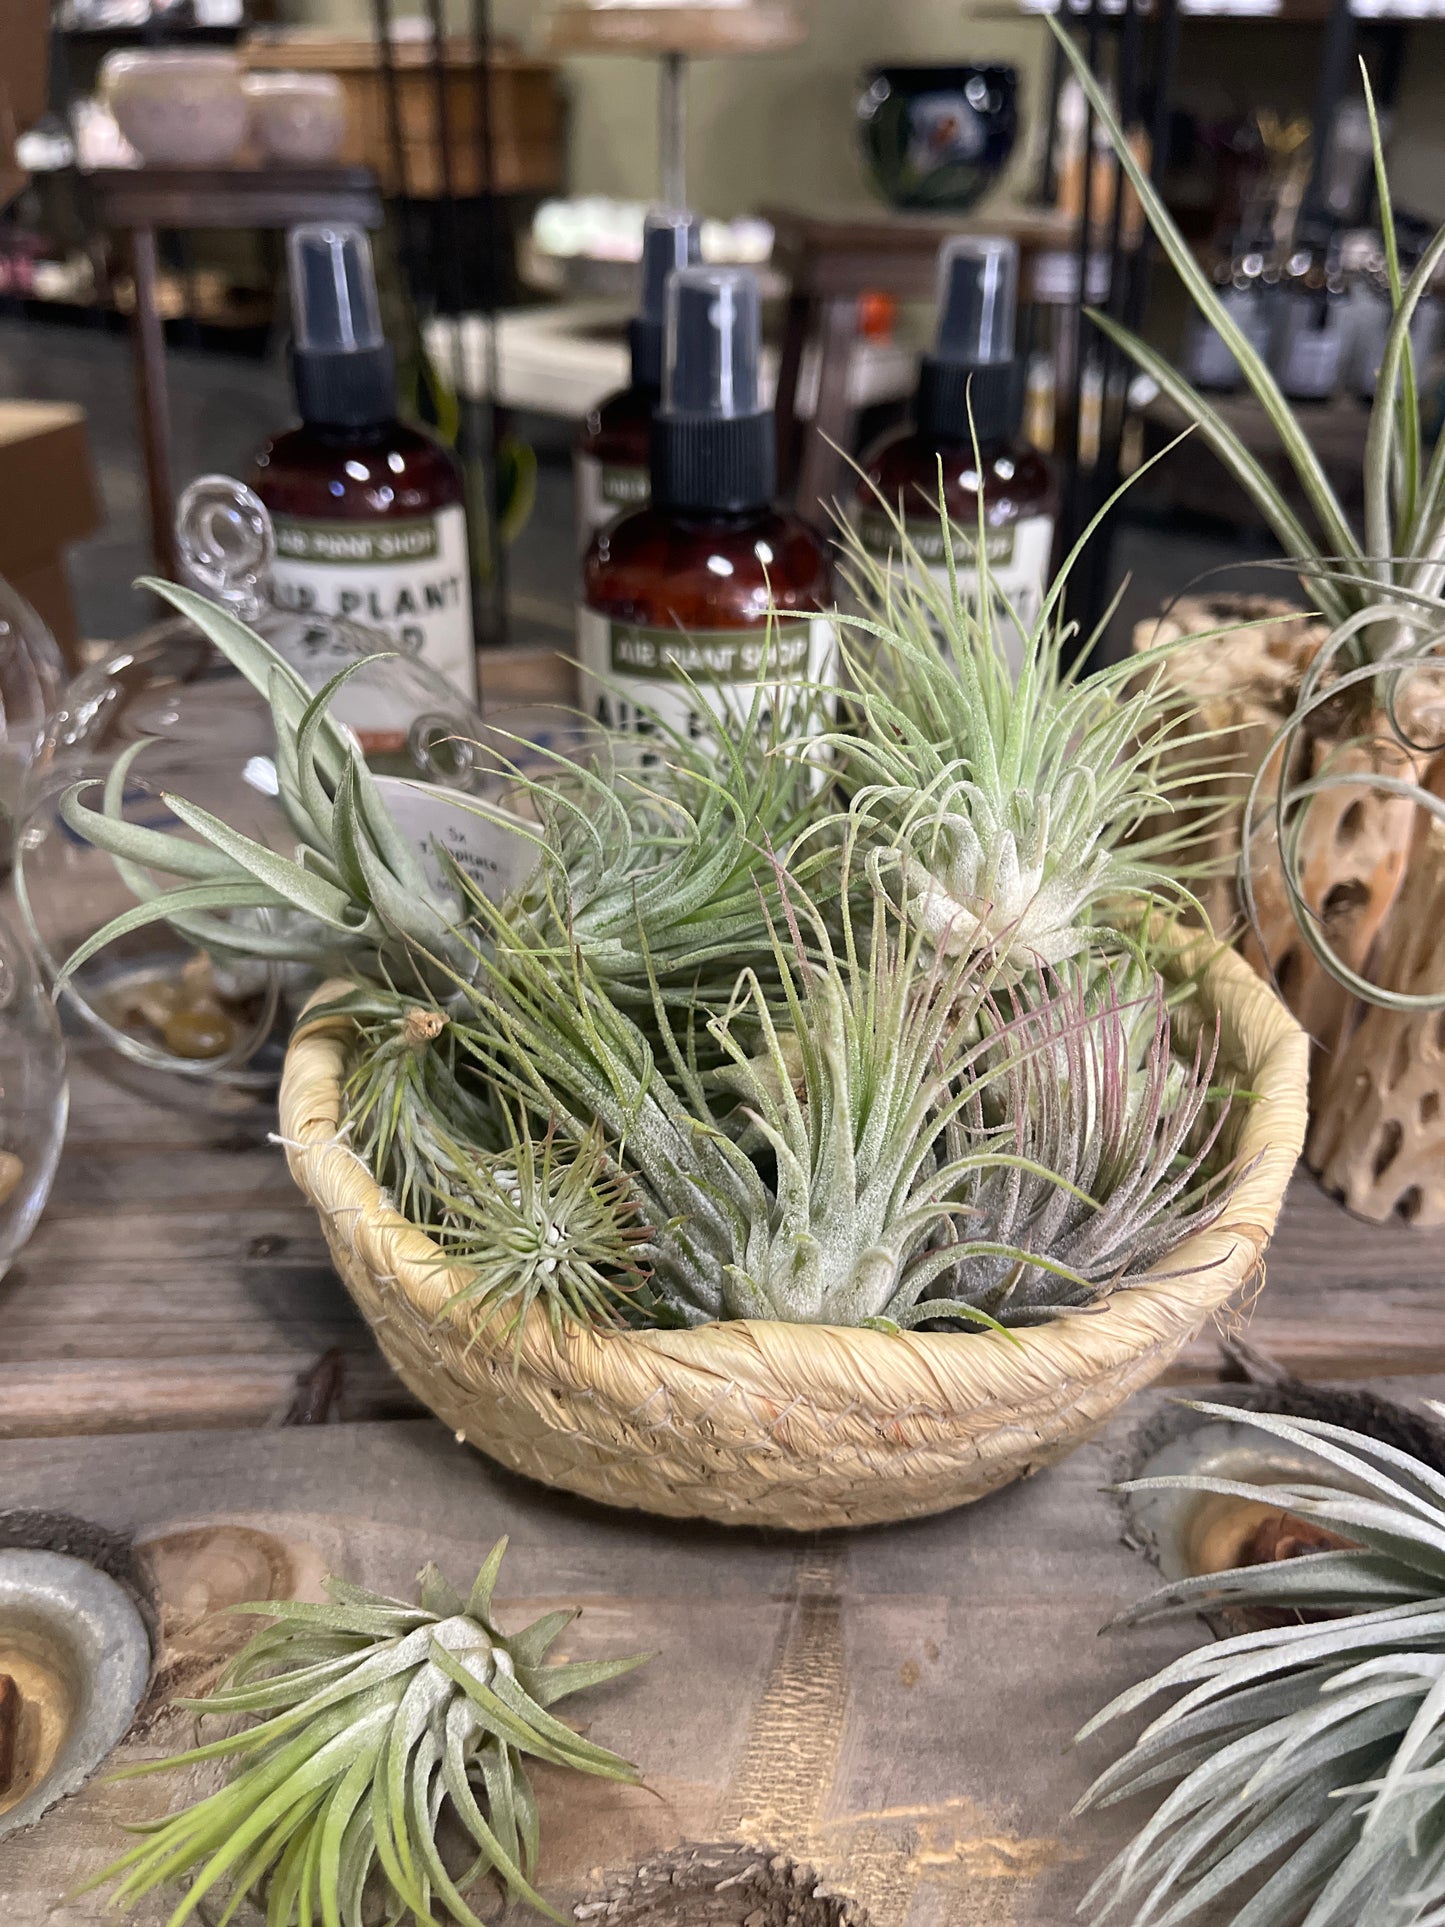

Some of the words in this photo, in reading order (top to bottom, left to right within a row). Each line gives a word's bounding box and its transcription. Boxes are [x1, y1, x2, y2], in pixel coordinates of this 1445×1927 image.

[339, 576, 459, 622] PLANT
[616, 638, 656, 669] AIR
[659, 643, 738, 672] PLANT
[740, 630, 808, 671] SHOP
